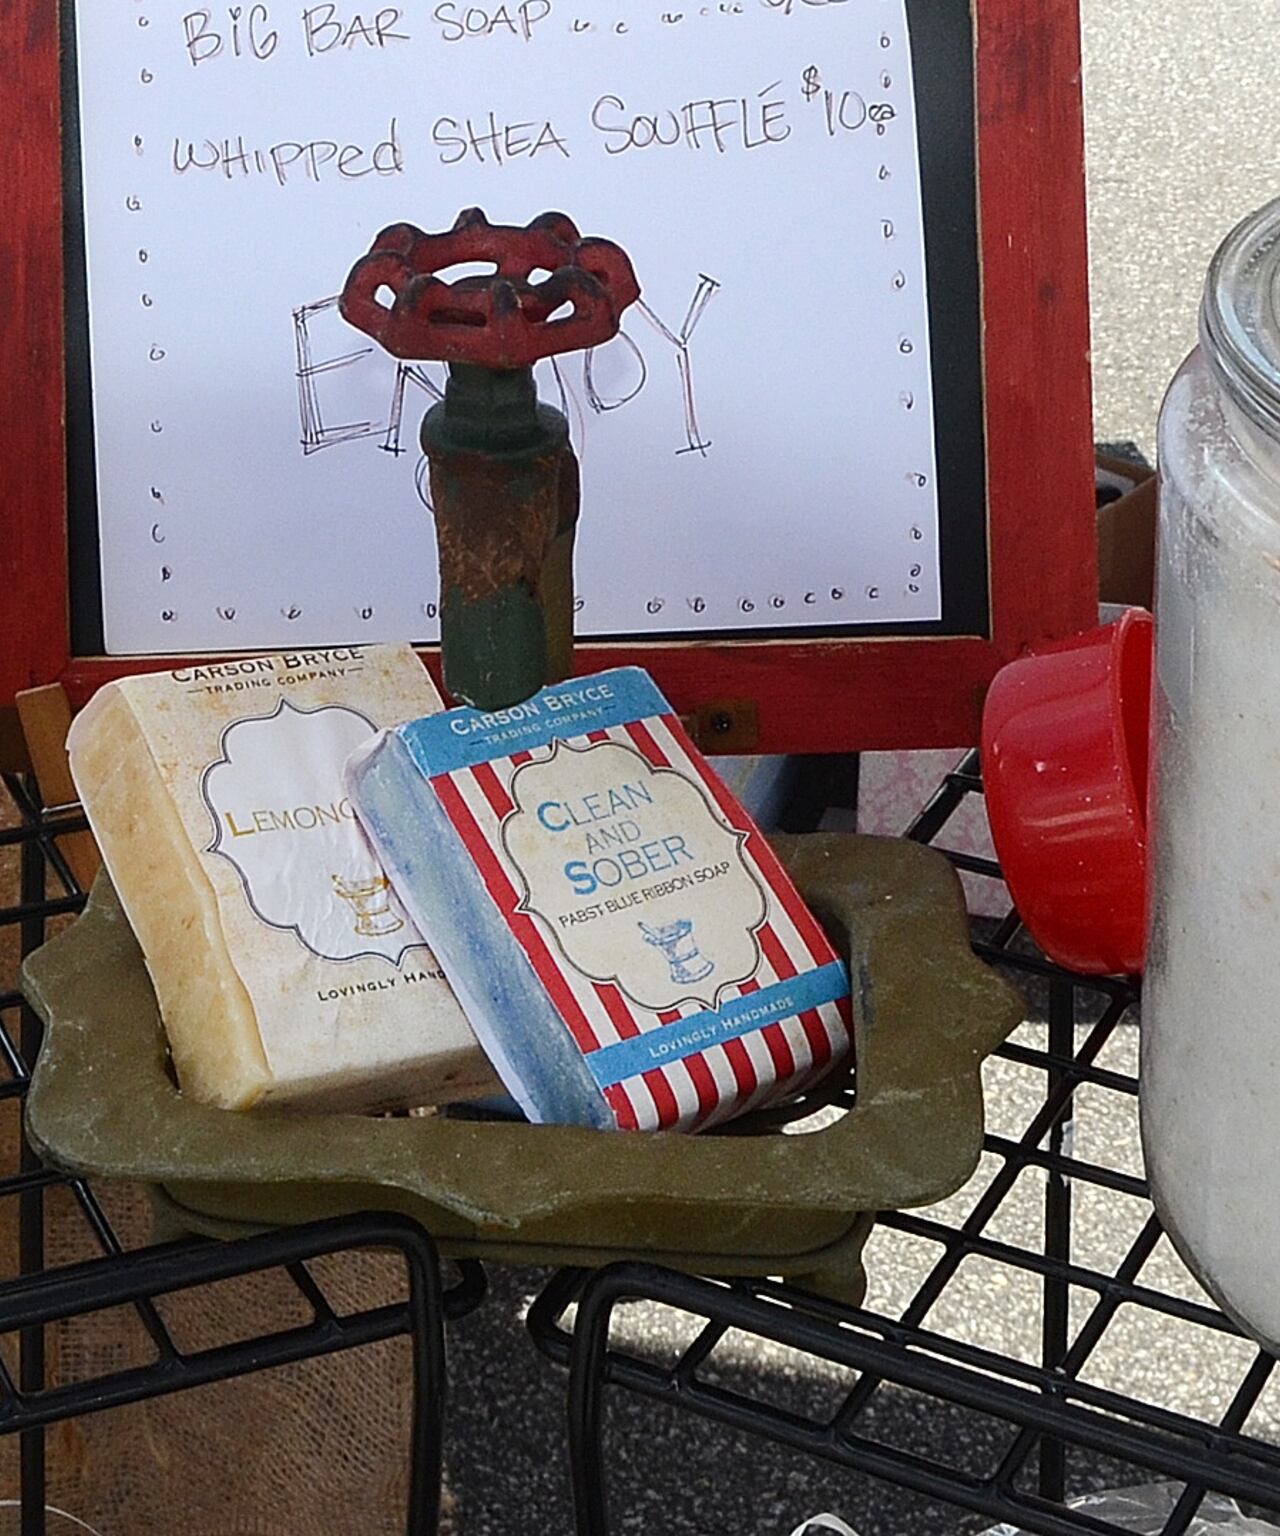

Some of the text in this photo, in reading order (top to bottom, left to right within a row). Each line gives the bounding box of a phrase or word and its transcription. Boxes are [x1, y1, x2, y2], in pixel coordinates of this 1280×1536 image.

[303, 3, 411, 57] BAR
[432, 112, 569, 166] SHEA
[171, 648, 364, 683] CARSON BRYCE
[206, 668, 346, 694] TRADING COMPANY
[450, 684, 614, 735] CARSON BRYCE
[484, 707, 605, 745] TRADING COMPANY
[537, 781, 653, 831] CLEAN
[586, 820, 642, 855] AND
[563, 835, 694, 895] SOBER
[558, 861, 731, 928] PABST BLUE RIBBON SOAP
[317, 978, 396, 1001] LOVINGLY
[649, 996, 795, 1059] LOVINGLY HANDMADE
